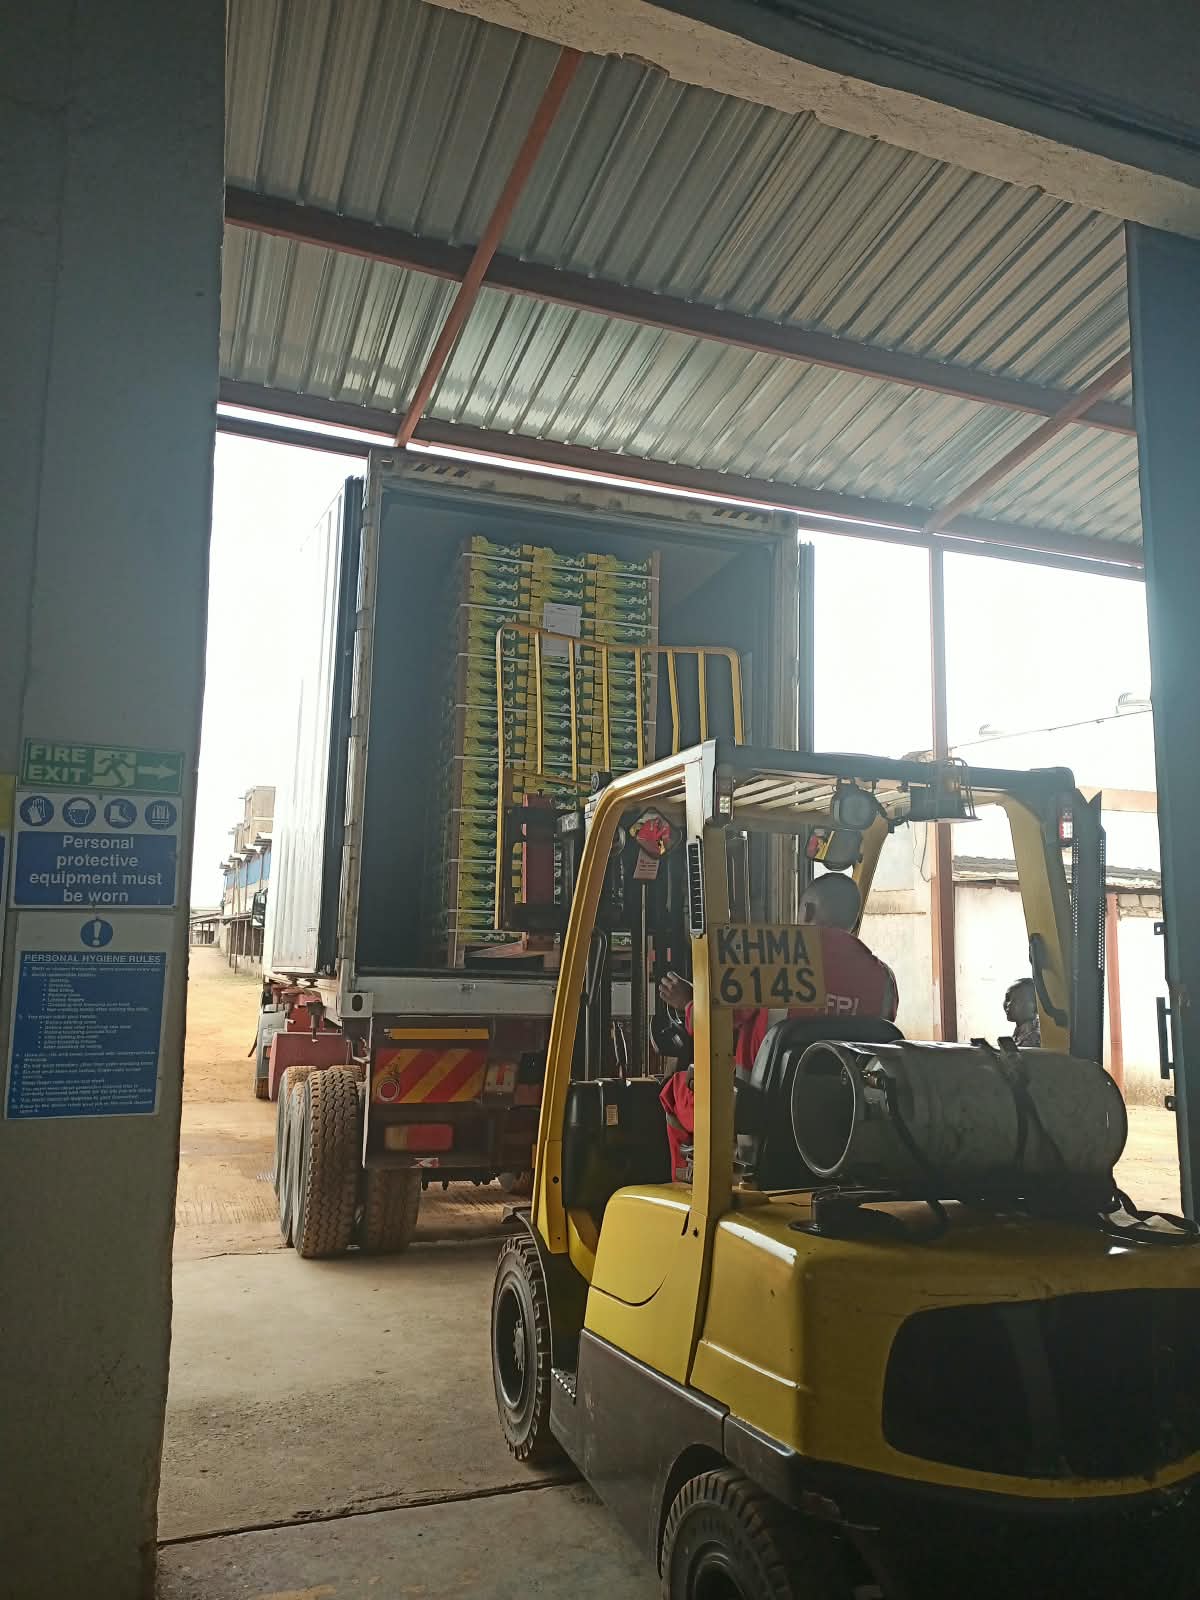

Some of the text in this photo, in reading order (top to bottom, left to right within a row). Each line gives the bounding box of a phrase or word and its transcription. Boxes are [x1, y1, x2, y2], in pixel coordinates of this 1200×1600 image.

[30, 745, 87, 763] FIRE
[29, 765, 85, 783] EXIT
[63, 835, 134, 849] Personal
[56, 854, 139, 869] protective
[30, 872, 162, 887] equipment must
[63, 889, 129, 902] be worn
[24, 953, 160, 963] PERSONAL HYGIENE RULES
[719, 967, 816, 1004] 614S
